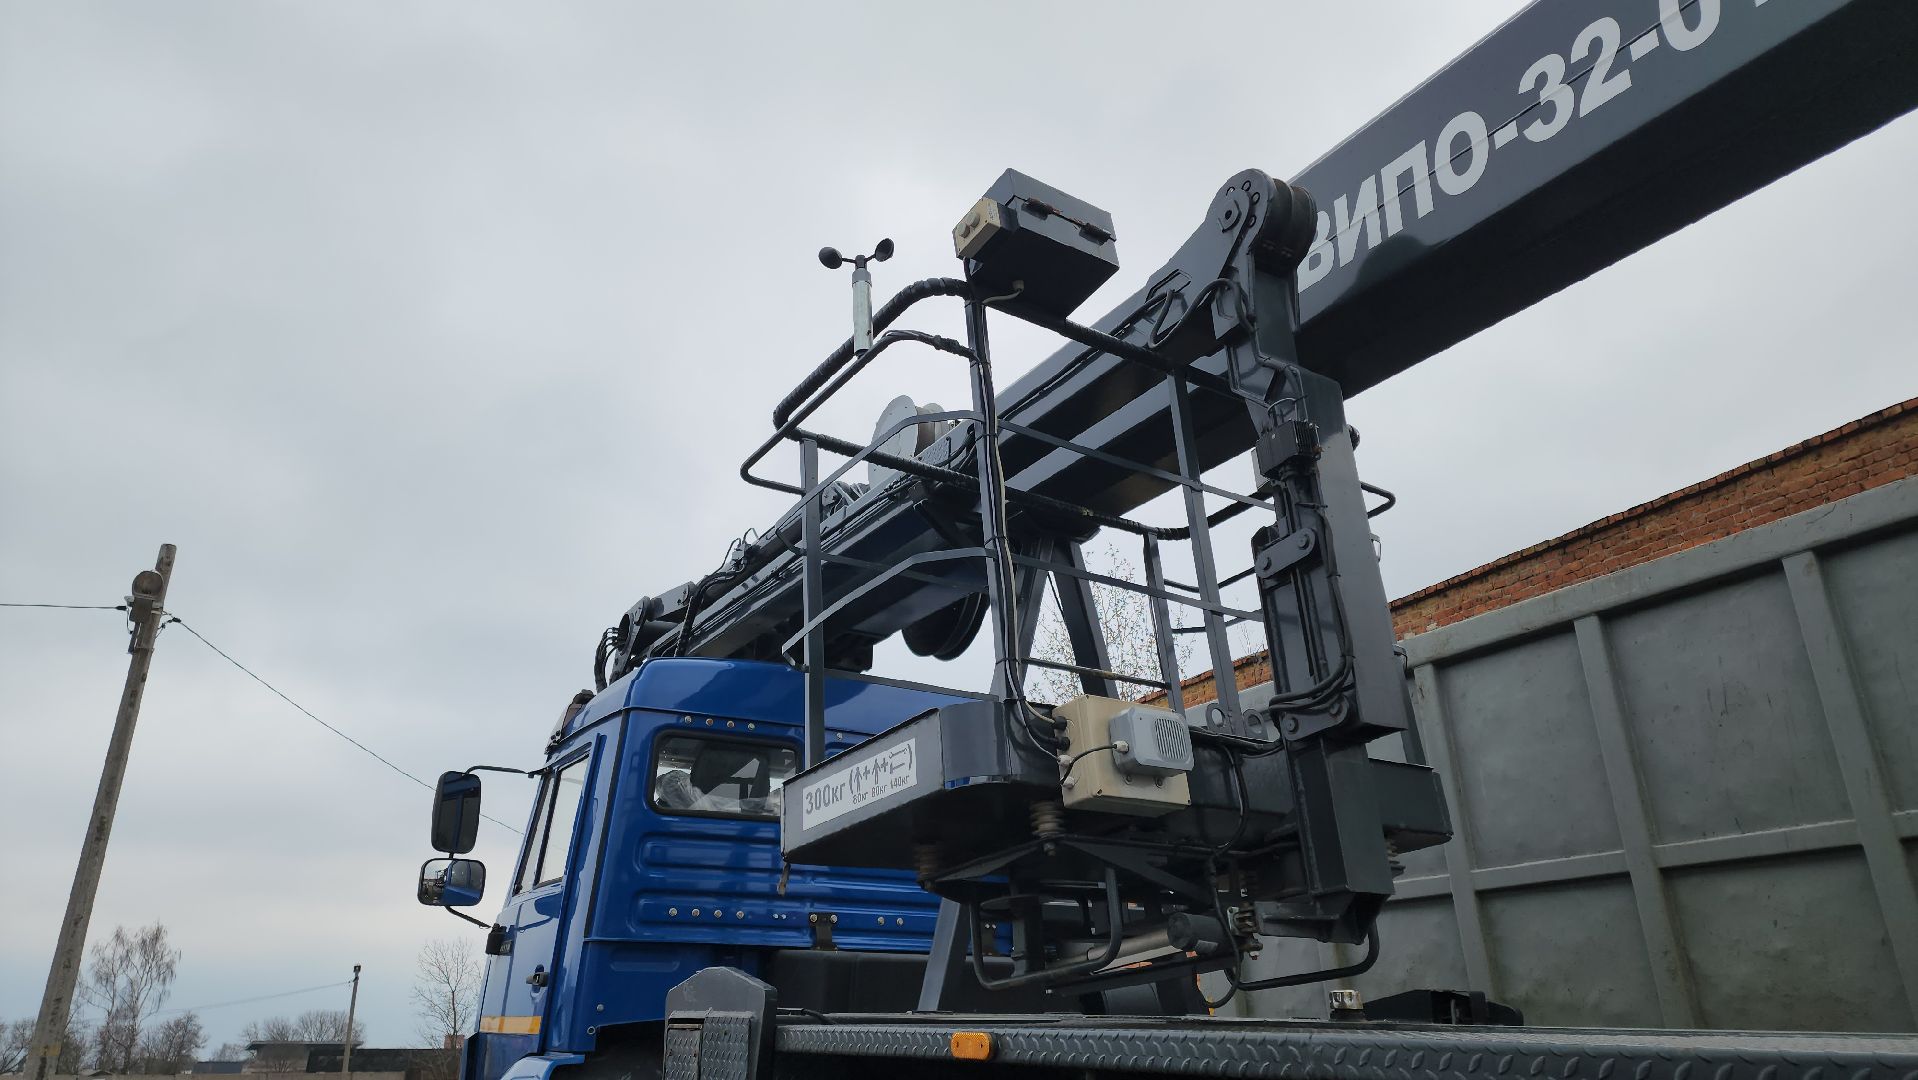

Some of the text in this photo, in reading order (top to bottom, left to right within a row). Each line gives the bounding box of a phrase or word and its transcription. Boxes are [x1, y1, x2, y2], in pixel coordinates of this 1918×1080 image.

[1297, 0, 1771, 293] ВИПО-32-0
[806, 782, 846, 815] 300кг
[871, 784, 888, 798] 80кг
[890, 774, 910, 789] 140кг
